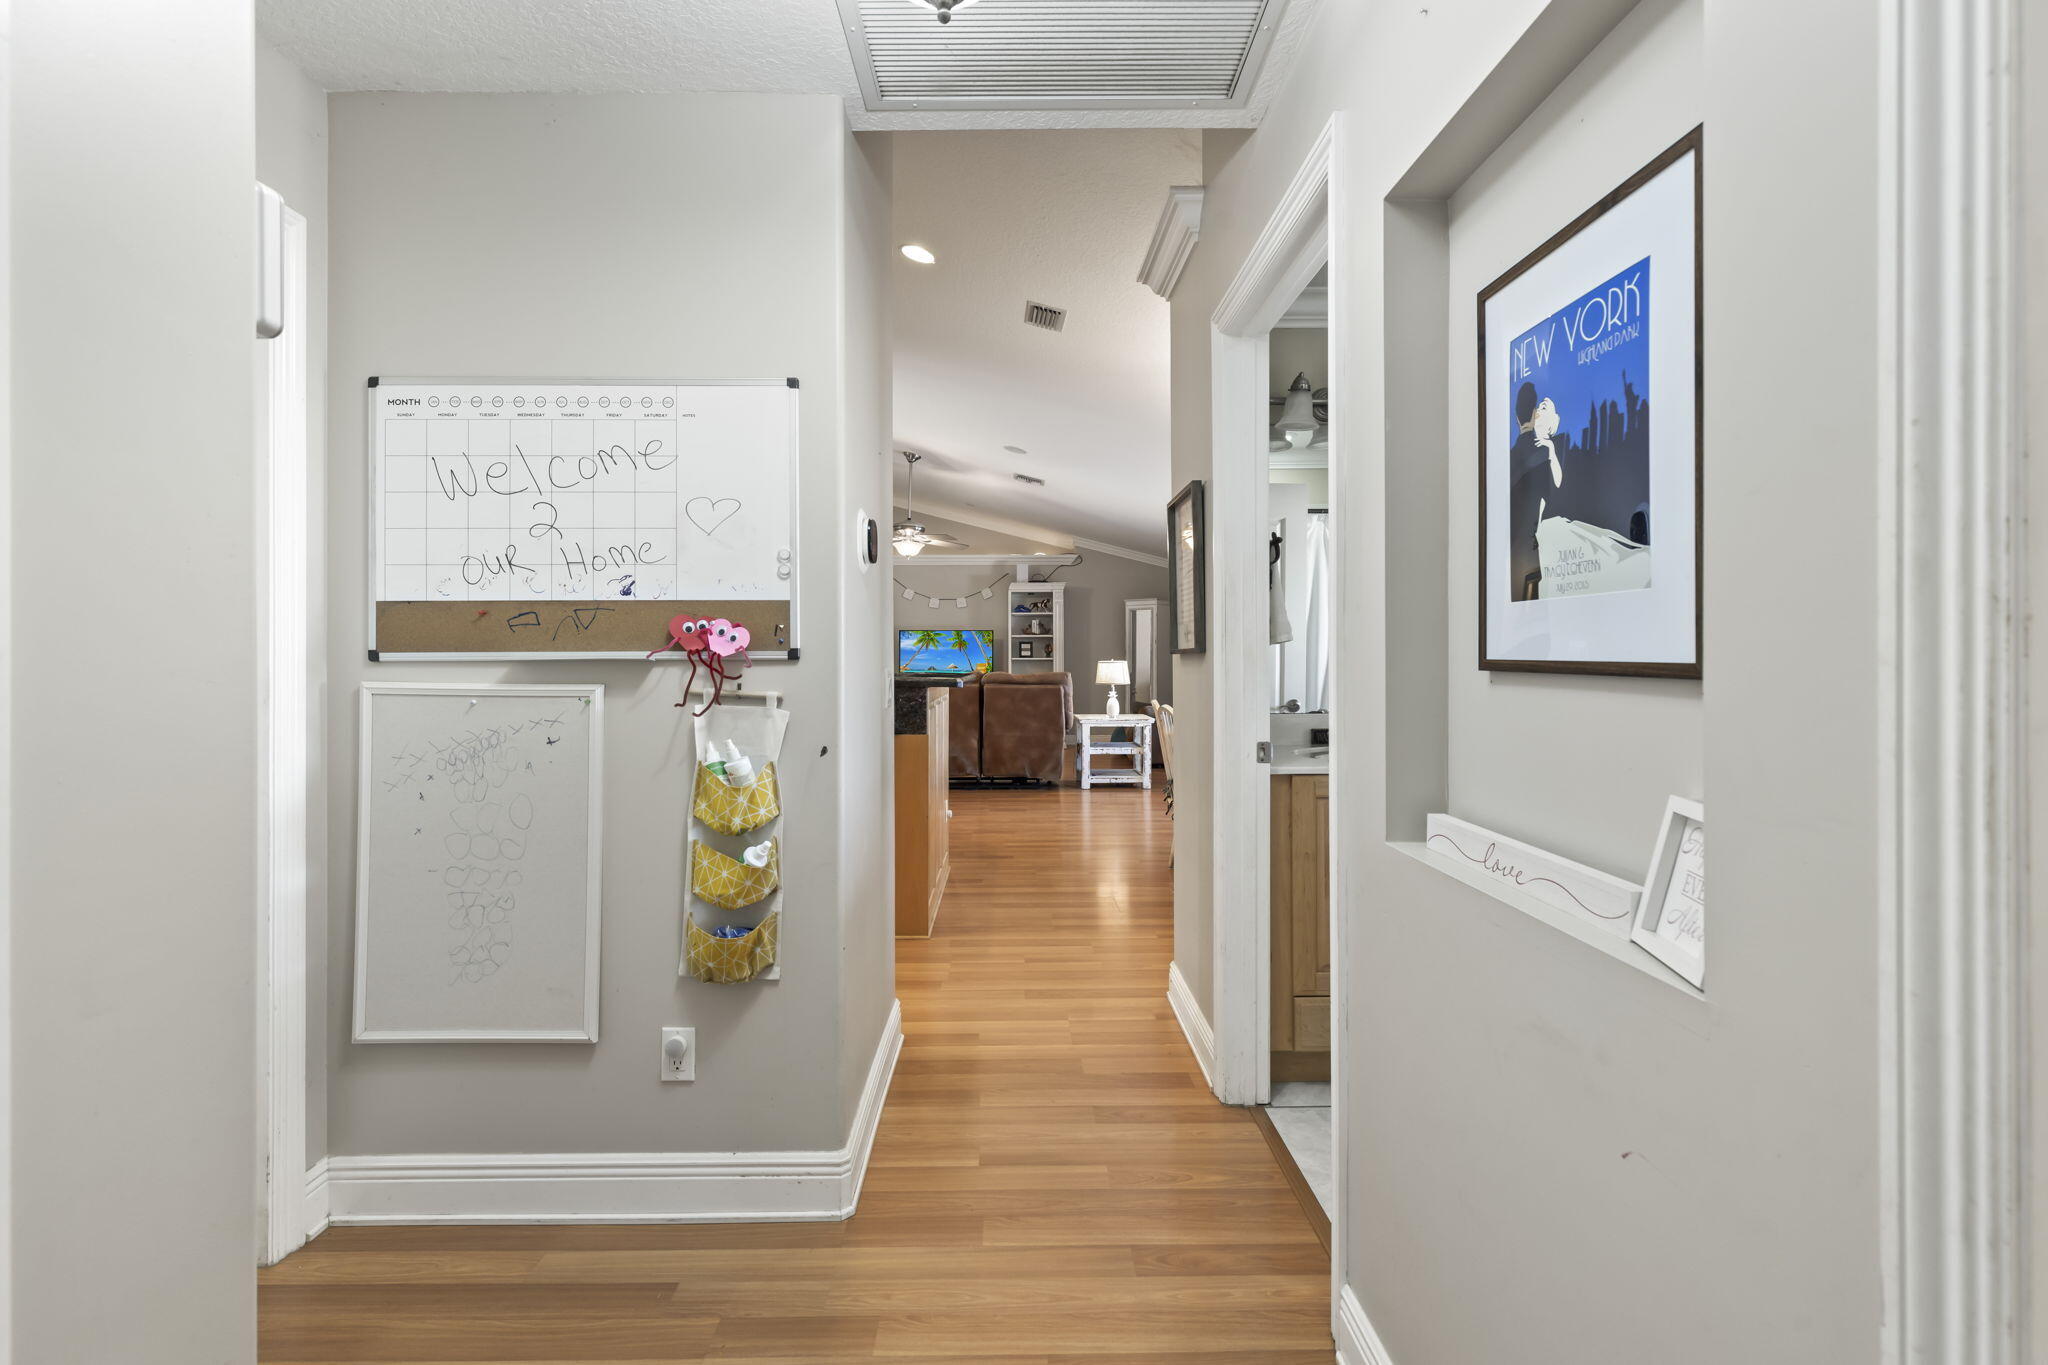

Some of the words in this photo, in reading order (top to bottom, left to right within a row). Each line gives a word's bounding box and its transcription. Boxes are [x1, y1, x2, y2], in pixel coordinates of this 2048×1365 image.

[1513, 322, 1556, 382] NEW
[1562, 272, 1641, 352] YORK
[387, 398, 421, 406] MONTH
[431, 439, 679, 501] Welcome
[529, 501, 563, 540] 2
[1481, 842, 1525, 885] love
